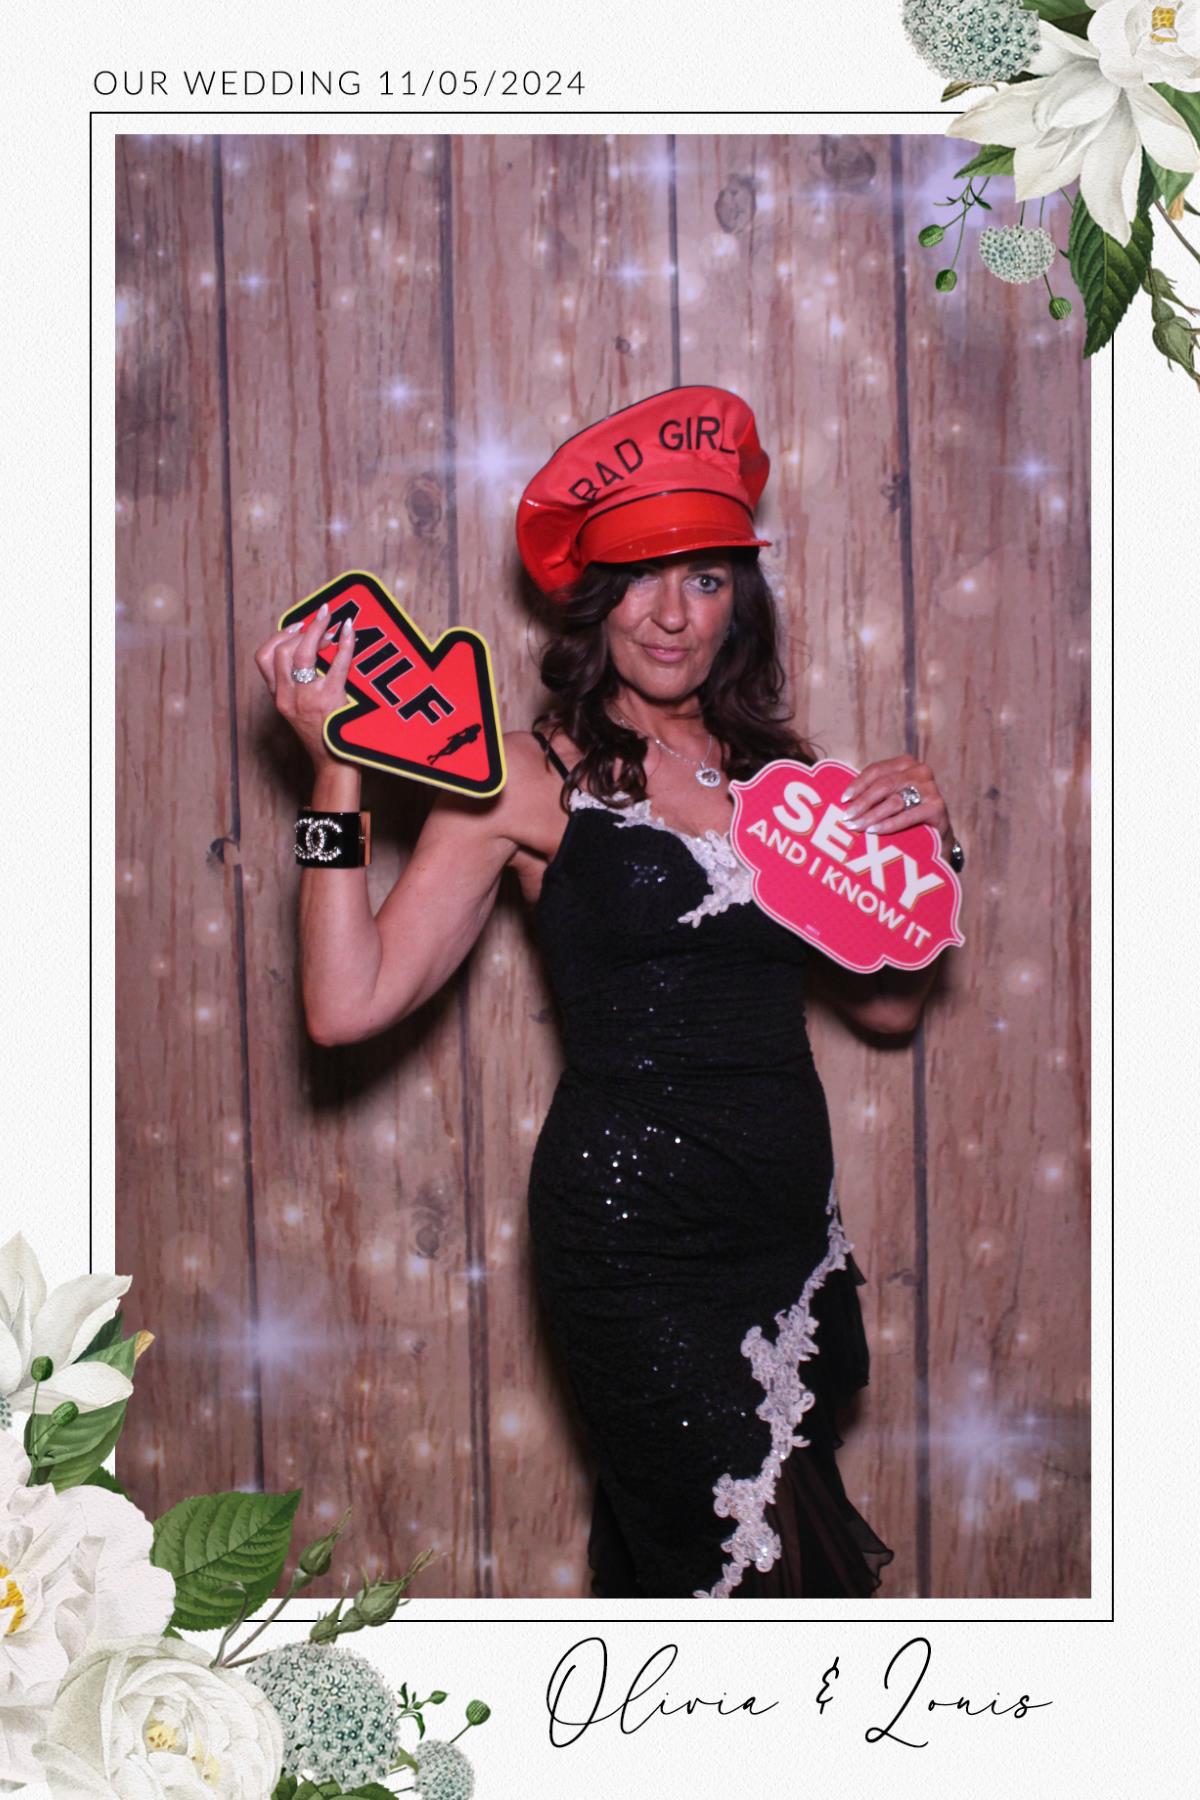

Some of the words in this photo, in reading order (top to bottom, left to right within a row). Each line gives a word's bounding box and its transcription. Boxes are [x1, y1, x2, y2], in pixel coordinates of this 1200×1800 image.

[568, 438, 643, 502] BAD
[659, 416, 736, 454] GIRL
[746, 819, 807, 865] AND
[808, 857, 822, 876] I
[821, 867, 905, 930] KNOW
[903, 921, 932, 948] IT
[772, 781, 945, 910] SEXY
